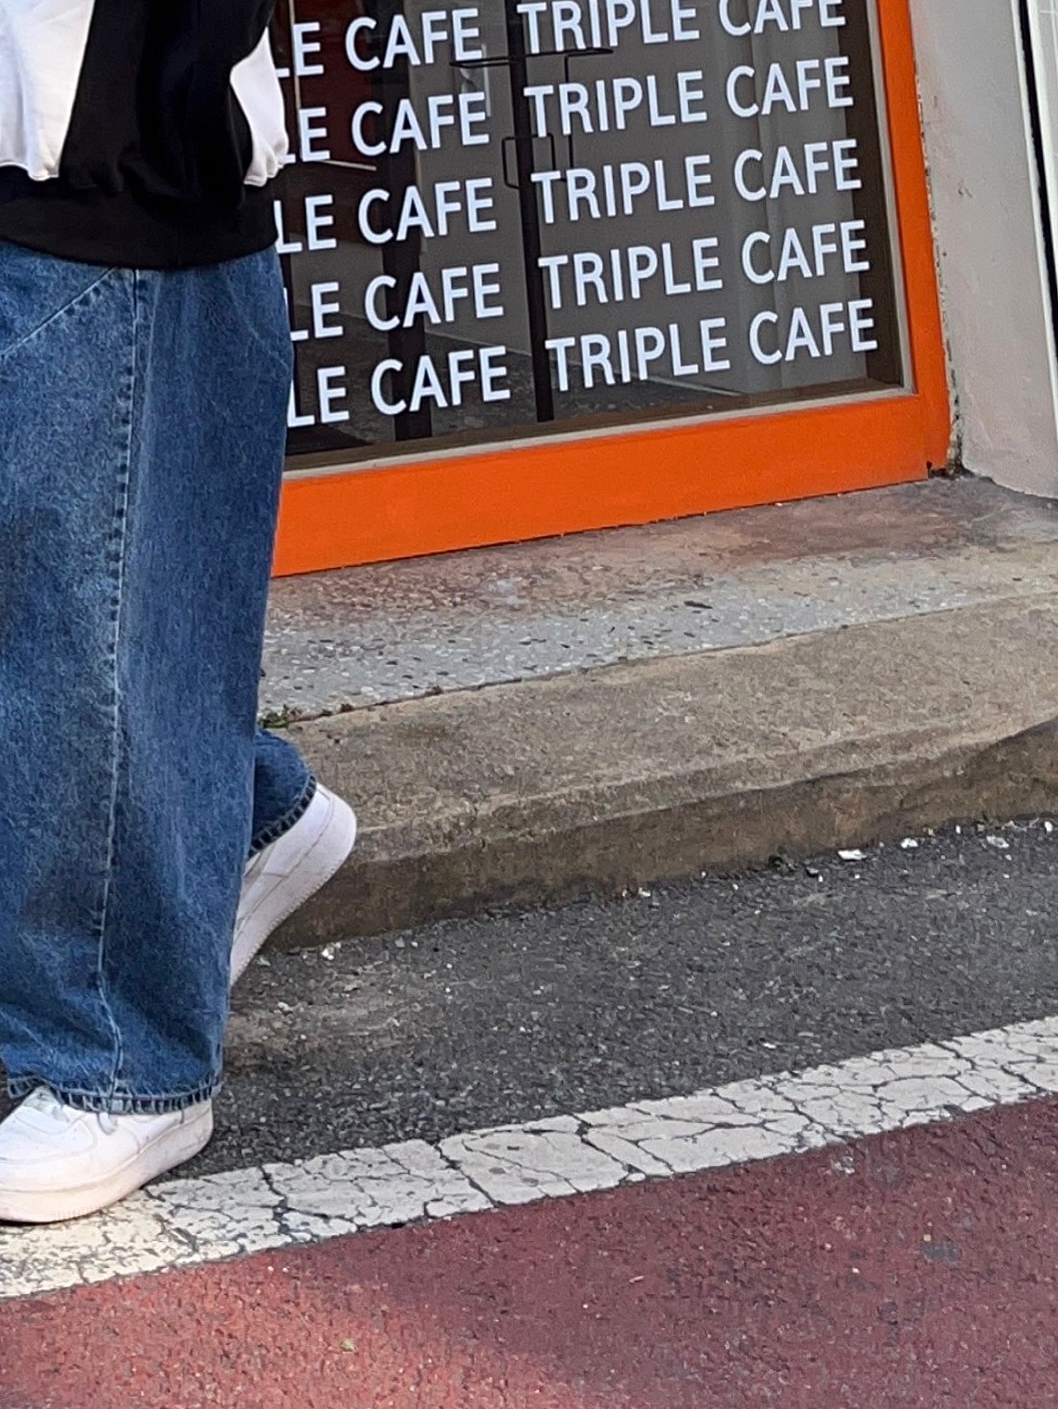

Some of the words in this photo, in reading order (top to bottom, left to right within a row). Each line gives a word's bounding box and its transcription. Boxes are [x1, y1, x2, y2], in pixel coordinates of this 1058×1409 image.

[346, 8, 482, 70] CAFE
[352, 92, 489, 155] CAFE
[524, 71, 707, 137] TRIPLE
[727, 57, 853, 117] CAFE
[359, 178, 496, 243] CAFE
[531, 155, 714, 223] TRIPLE
[735, 139, 861, 201] CAFE
[365, 263, 503, 330] CAFE
[538, 237, 722, 308] TRIPLE
[742, 220, 869, 283] CAFE
[372, 346, 510, 414] CAFE
[545, 318, 730, 391] TRIPLE
[750, 299, 877, 364] CAFE
